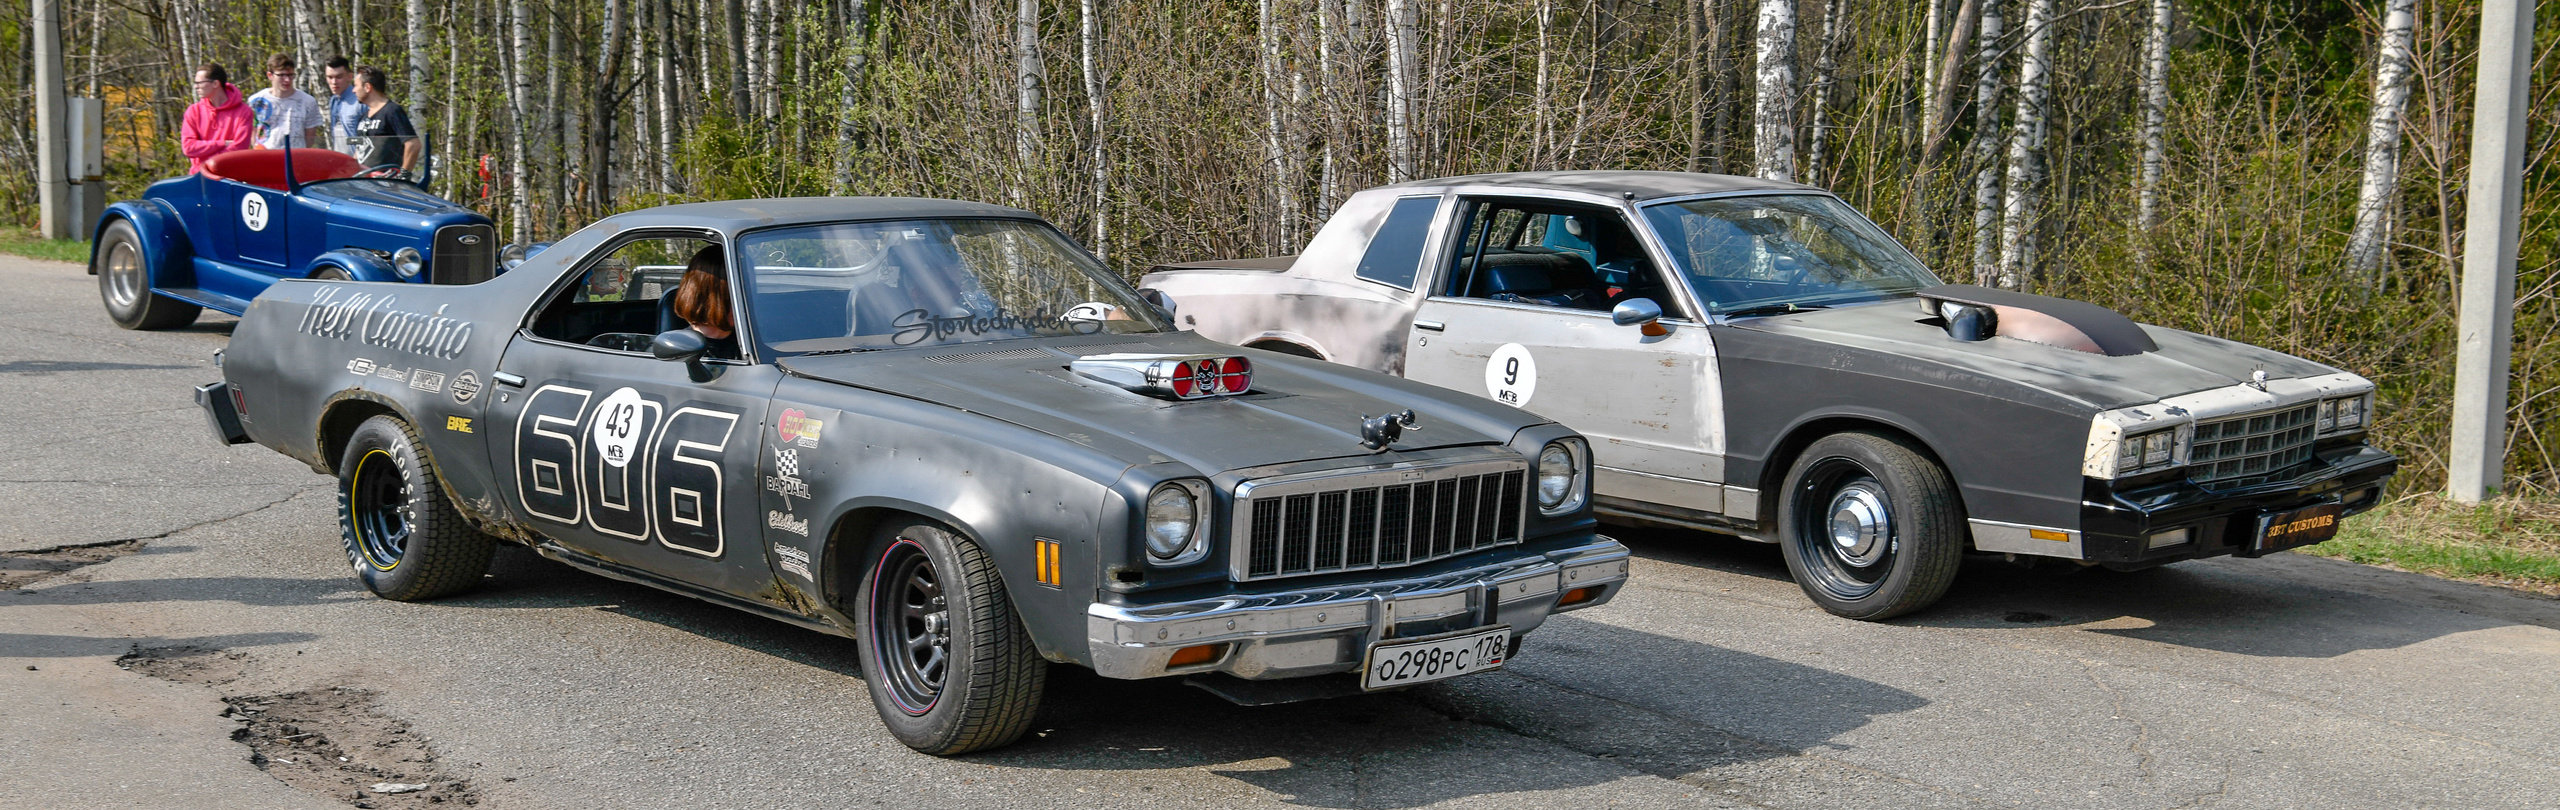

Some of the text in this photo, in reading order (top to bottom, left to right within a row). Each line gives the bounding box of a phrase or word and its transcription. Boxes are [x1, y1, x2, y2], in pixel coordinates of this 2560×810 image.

[248, 200, 262, 218] 67
[298, 284, 474, 361] Hell Camino
[414, 371, 442, 386] SIMPSON
[1504, 356, 1519, 386] 9
[606, 403, 635, 439] 43
[514, 384, 740, 558] 606
[766, 476, 811, 500] BARDAHL
[768, 510, 809, 538] Edelbrock
[2287, 514, 2334, 534] CUSTOMS
[1475, 634, 1503, 659] 178
[1475, 660, 1491, 668] RUS
